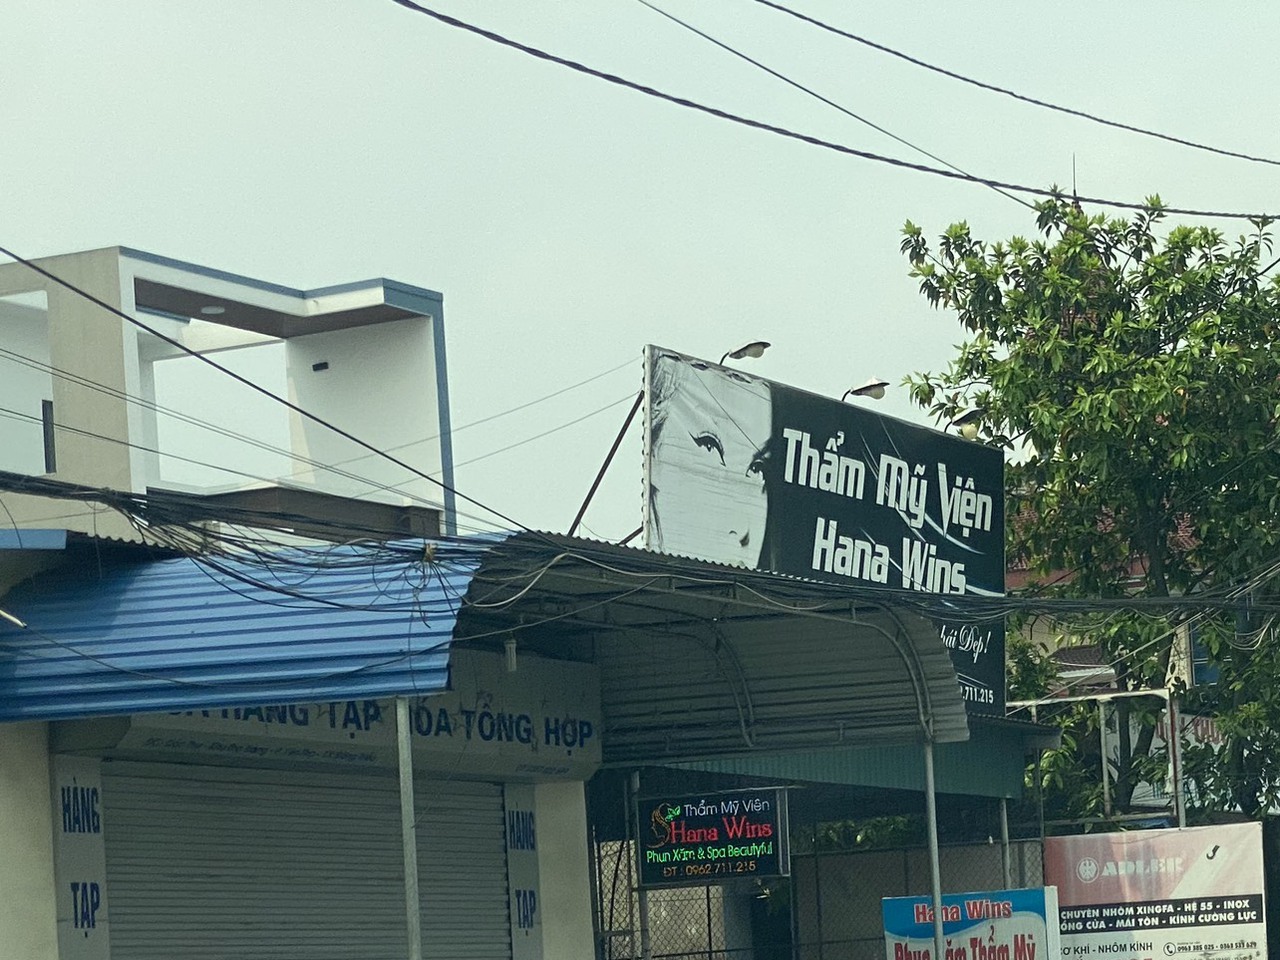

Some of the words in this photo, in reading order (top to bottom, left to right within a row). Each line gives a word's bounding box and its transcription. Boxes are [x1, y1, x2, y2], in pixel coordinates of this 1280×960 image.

[783, 428, 865, 500] Thẩm
[876, 453, 927, 529] Mỹ
[937, 463, 992, 538] Viện
[812, 517, 890, 584] Hana
[902, 537, 967, 595] Wins
[940, 624, 957, 648] hái
[960, 685, 994, 704] .711.215
[327, 699, 383, 739] TẠP
[61, 777, 100, 833] HÀNG
[684, 800, 717, 817] Thẩm
[721, 800, 739, 816] Mỹ
[508, 801, 536, 850] HÀNG
[670, 820, 719, 844] Hana
[722, 815, 773, 840] Wins
[646, 849, 671, 863] Phun
[707, 845, 726, 861] Spa
[70, 882, 101, 939] TẠP
[515, 889, 537, 937] TẠP
[914, 903, 961, 924] Hana
[965, 899, 1013, 920] Wins
[1060, 908, 1100, 920] CHUYÊN
[1102, 905, 1134, 917] NHÔM
[1136, 902, 1174, 915] XINGFA
[1184, 900, 1198, 914] HỆ
[1200, 901, 1213, 911] 55
[1223, 899, 1250, 910] INOX
[1169, 914, 1195, 925] KÍNH
[1237, 910, 1257, 922] LỰC
[1061, 946, 1072, 956] Ơ
[1073, 942, 1090, 955] KHÍ
[1098, 941, 1127, 954] NHÔM
[1129, 941, 1153, 952] KÍNH
